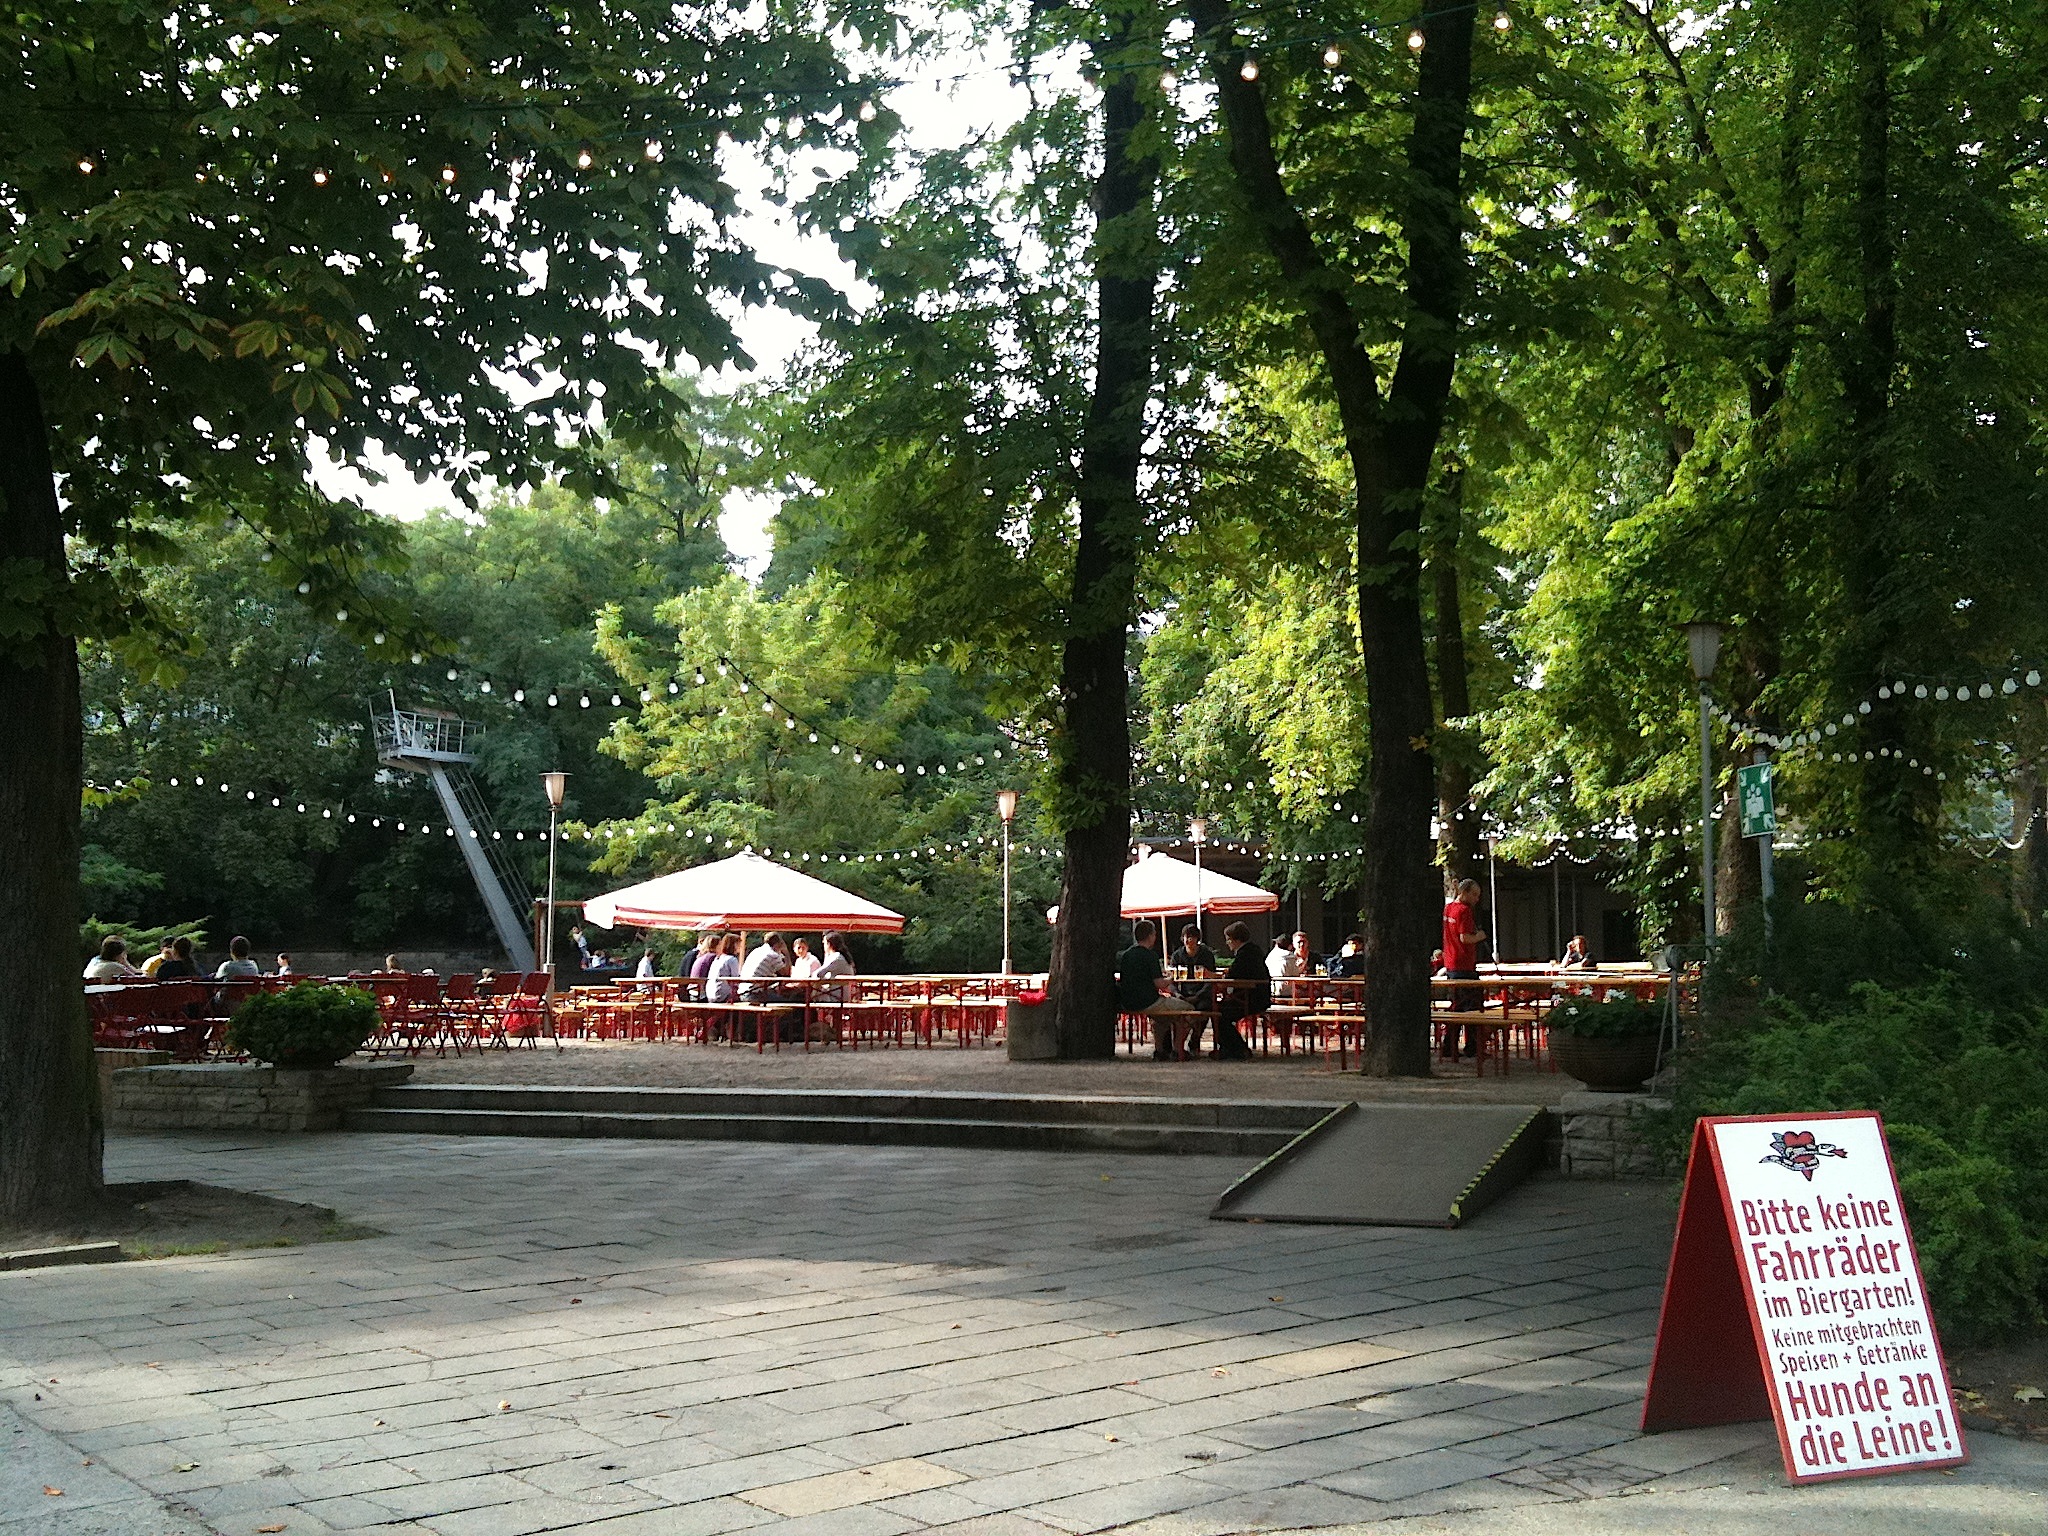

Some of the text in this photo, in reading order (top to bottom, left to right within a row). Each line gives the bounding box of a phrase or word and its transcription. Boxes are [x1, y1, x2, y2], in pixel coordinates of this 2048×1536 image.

[1741, 1194, 1892, 1236] Bitte keine
[1752, 1234, 1901, 1283] Fahrräder
[1763, 1278, 1915, 1318] im Biergarten!
[1772, 1318, 1922, 1348] Keine mitgebrachten
[1780, 1341, 1928, 1377] Speisen + Getränke
[1786, 1371, 1939, 1421] Hunde an
[1800, 1409, 1952, 1466] die Leine!
